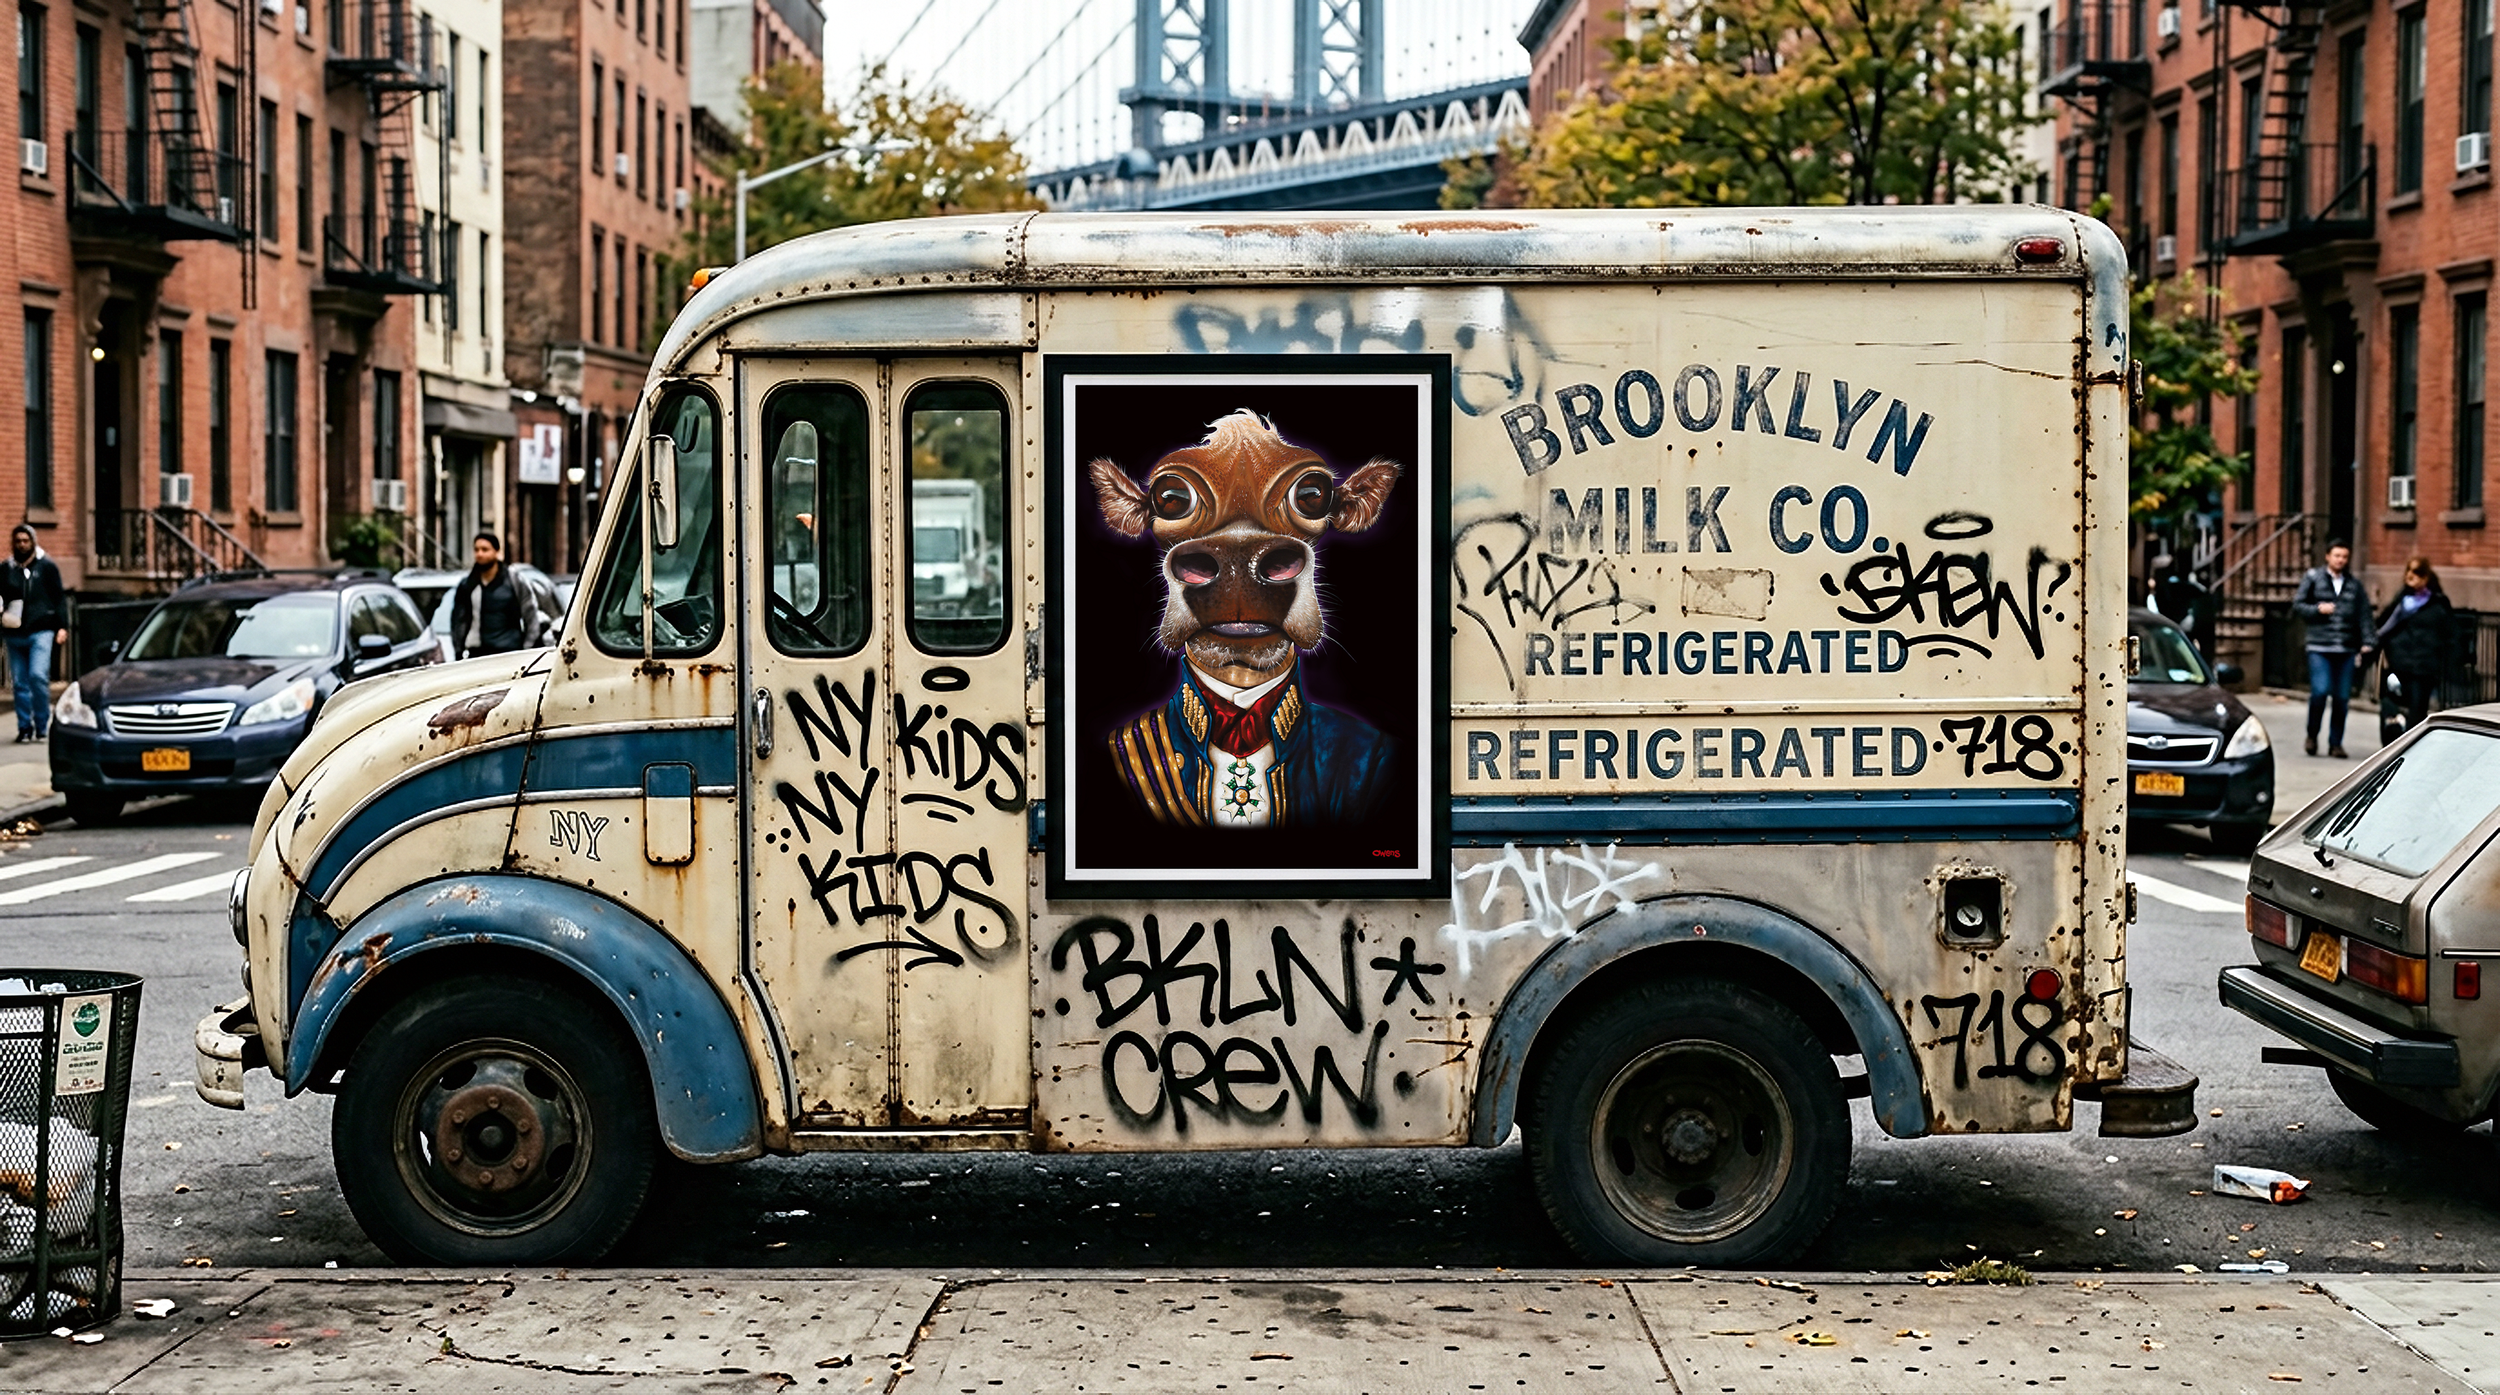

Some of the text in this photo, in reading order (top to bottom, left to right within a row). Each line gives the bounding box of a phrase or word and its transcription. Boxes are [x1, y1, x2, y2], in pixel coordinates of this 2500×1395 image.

[1501, 363, 1935, 477] BROOKLYN
[1549, 484, 1890, 554] MILK CO.
[1525, 630, 1909, 676] REFRIGERATED
[785, 667, 876, 770] NY
[1466, 727, 1928, 780] REFRIGERATED
[1940, 714, 2064, 781] 718
[549, 809, 610, 861] NY
[775, 767, 880, 853] NY
[797, 846, 1022, 970] KIDS
[1052, 913, 1364, 1034] BKLN
[1920, 989, 2066, 1090] 718
